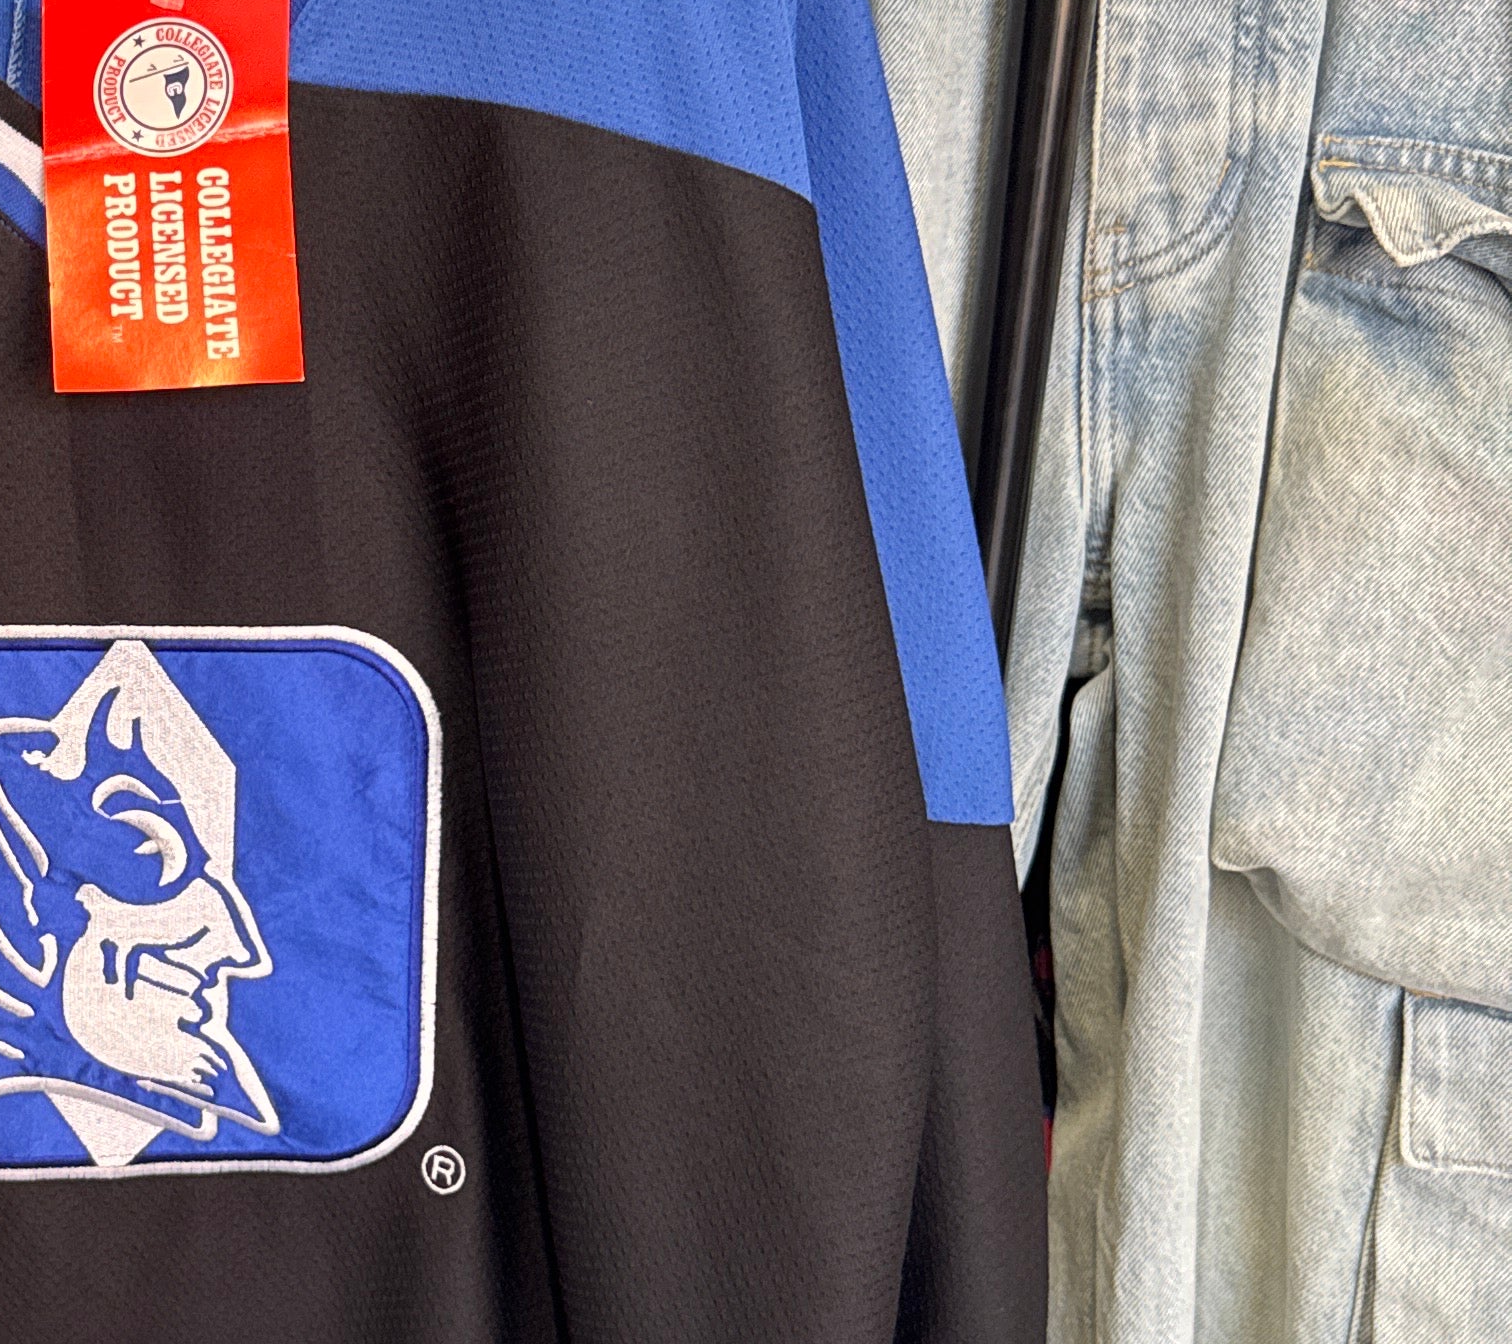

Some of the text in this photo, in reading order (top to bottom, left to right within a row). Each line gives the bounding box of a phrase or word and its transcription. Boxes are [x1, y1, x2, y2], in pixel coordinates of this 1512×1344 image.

[104, 27, 224, 148] COLLEGIATE LICENSED PRODUCT
[104, 173, 144, 321] PRODUCT
[149, 171, 189, 325] LICENSED
[196, 167, 240, 360] COLLEGIATE
